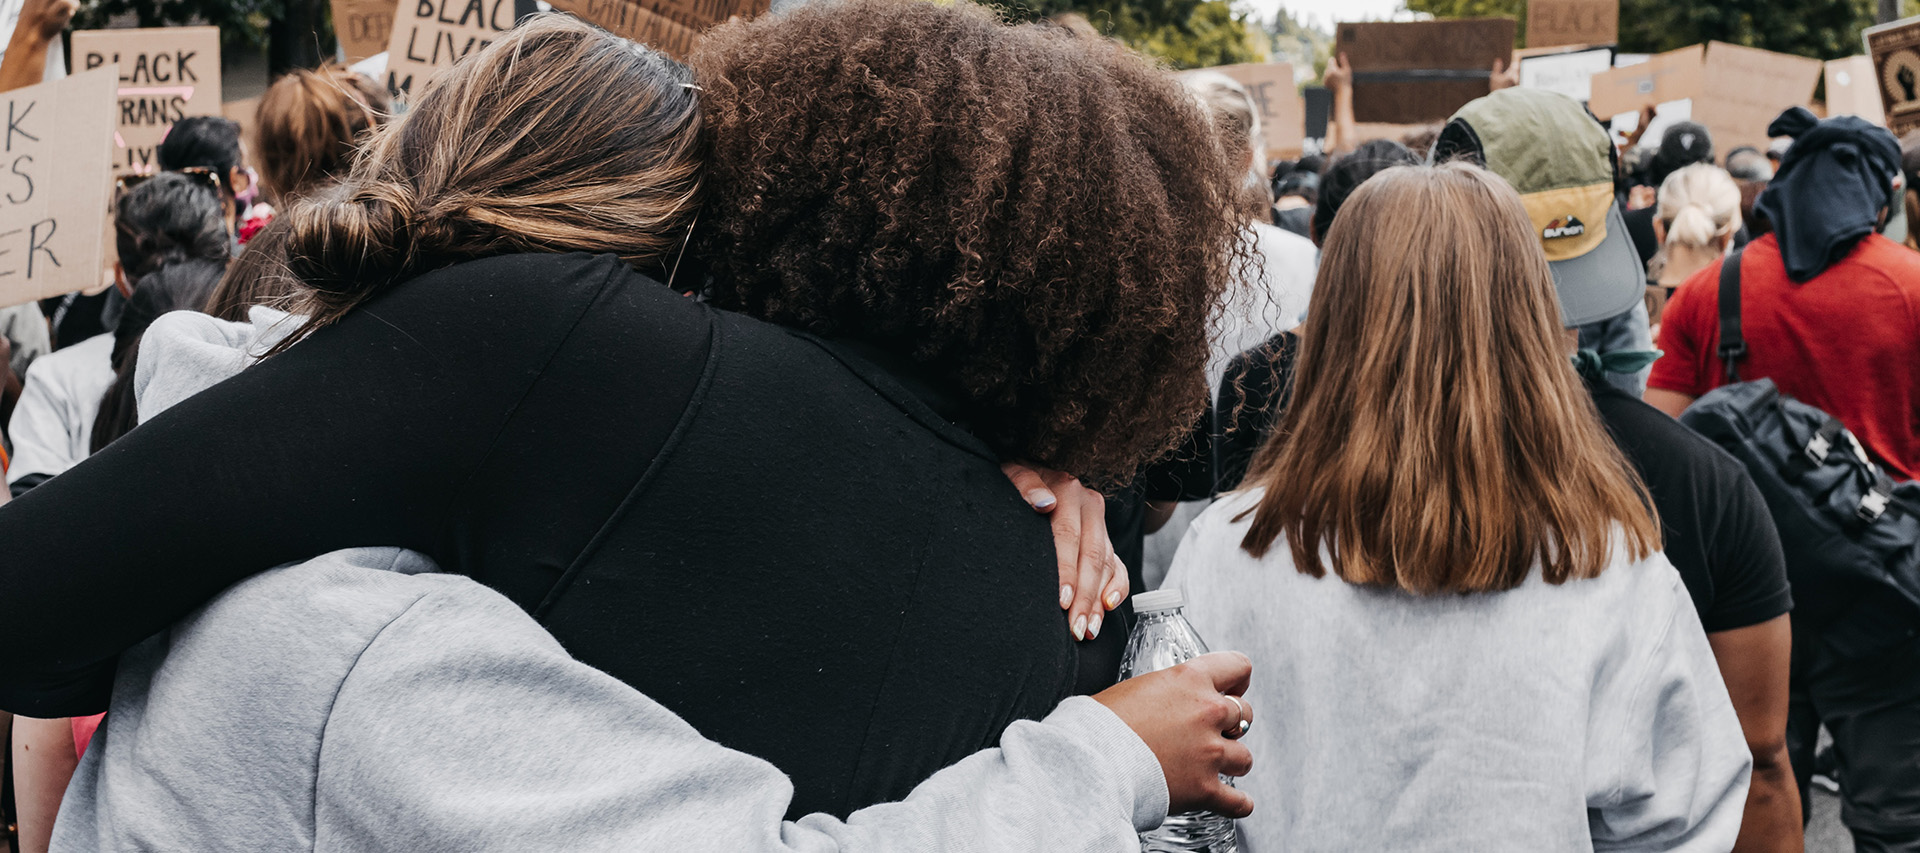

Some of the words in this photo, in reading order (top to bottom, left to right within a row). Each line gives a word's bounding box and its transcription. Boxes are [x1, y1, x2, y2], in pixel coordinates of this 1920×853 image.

[415, 0, 514, 31] BLAC
[407, 27, 493, 65] LIV
[117, 97, 188, 125] RANS
[0, 154, 34, 204] S
